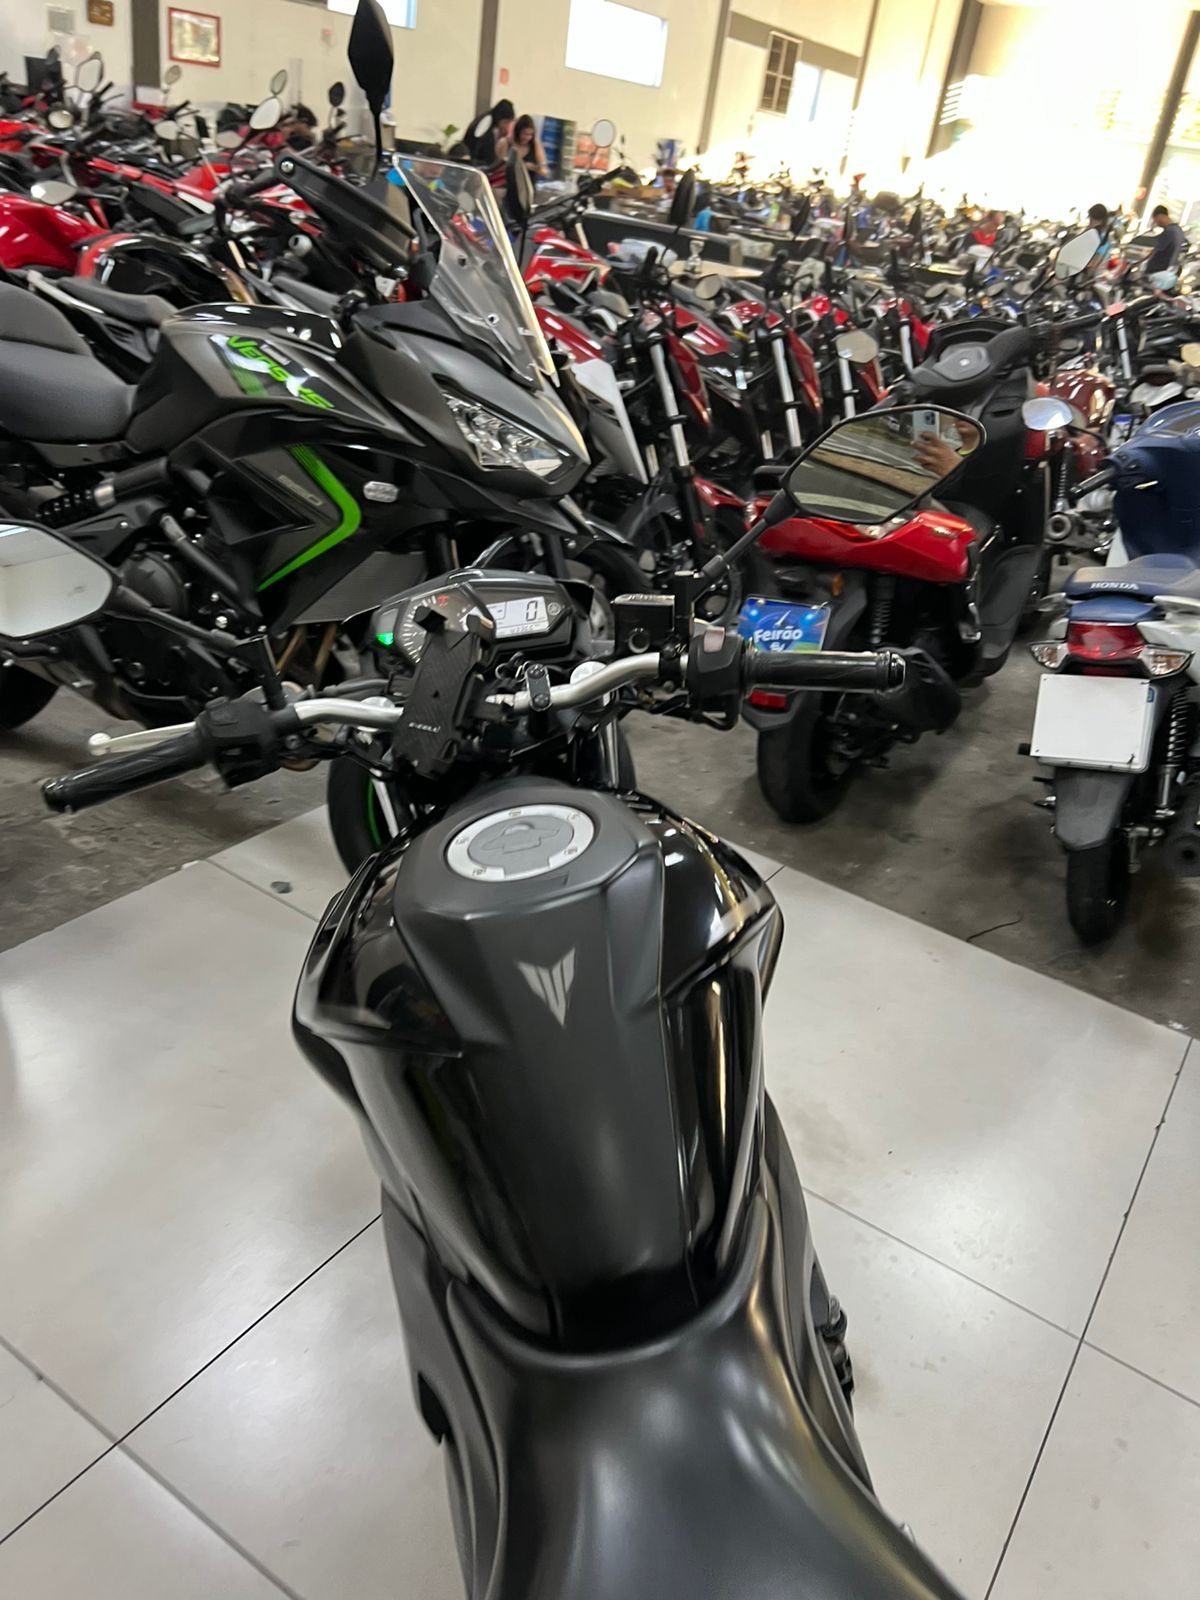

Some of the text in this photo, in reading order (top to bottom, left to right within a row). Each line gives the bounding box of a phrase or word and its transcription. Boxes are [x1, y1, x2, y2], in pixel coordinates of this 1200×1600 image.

[227, 336, 335, 408] VERSS
[1090, 582, 1139, 590] HONDA
[526, 600, 538, 621] 0
[754, 625, 804, 643] Feirão
